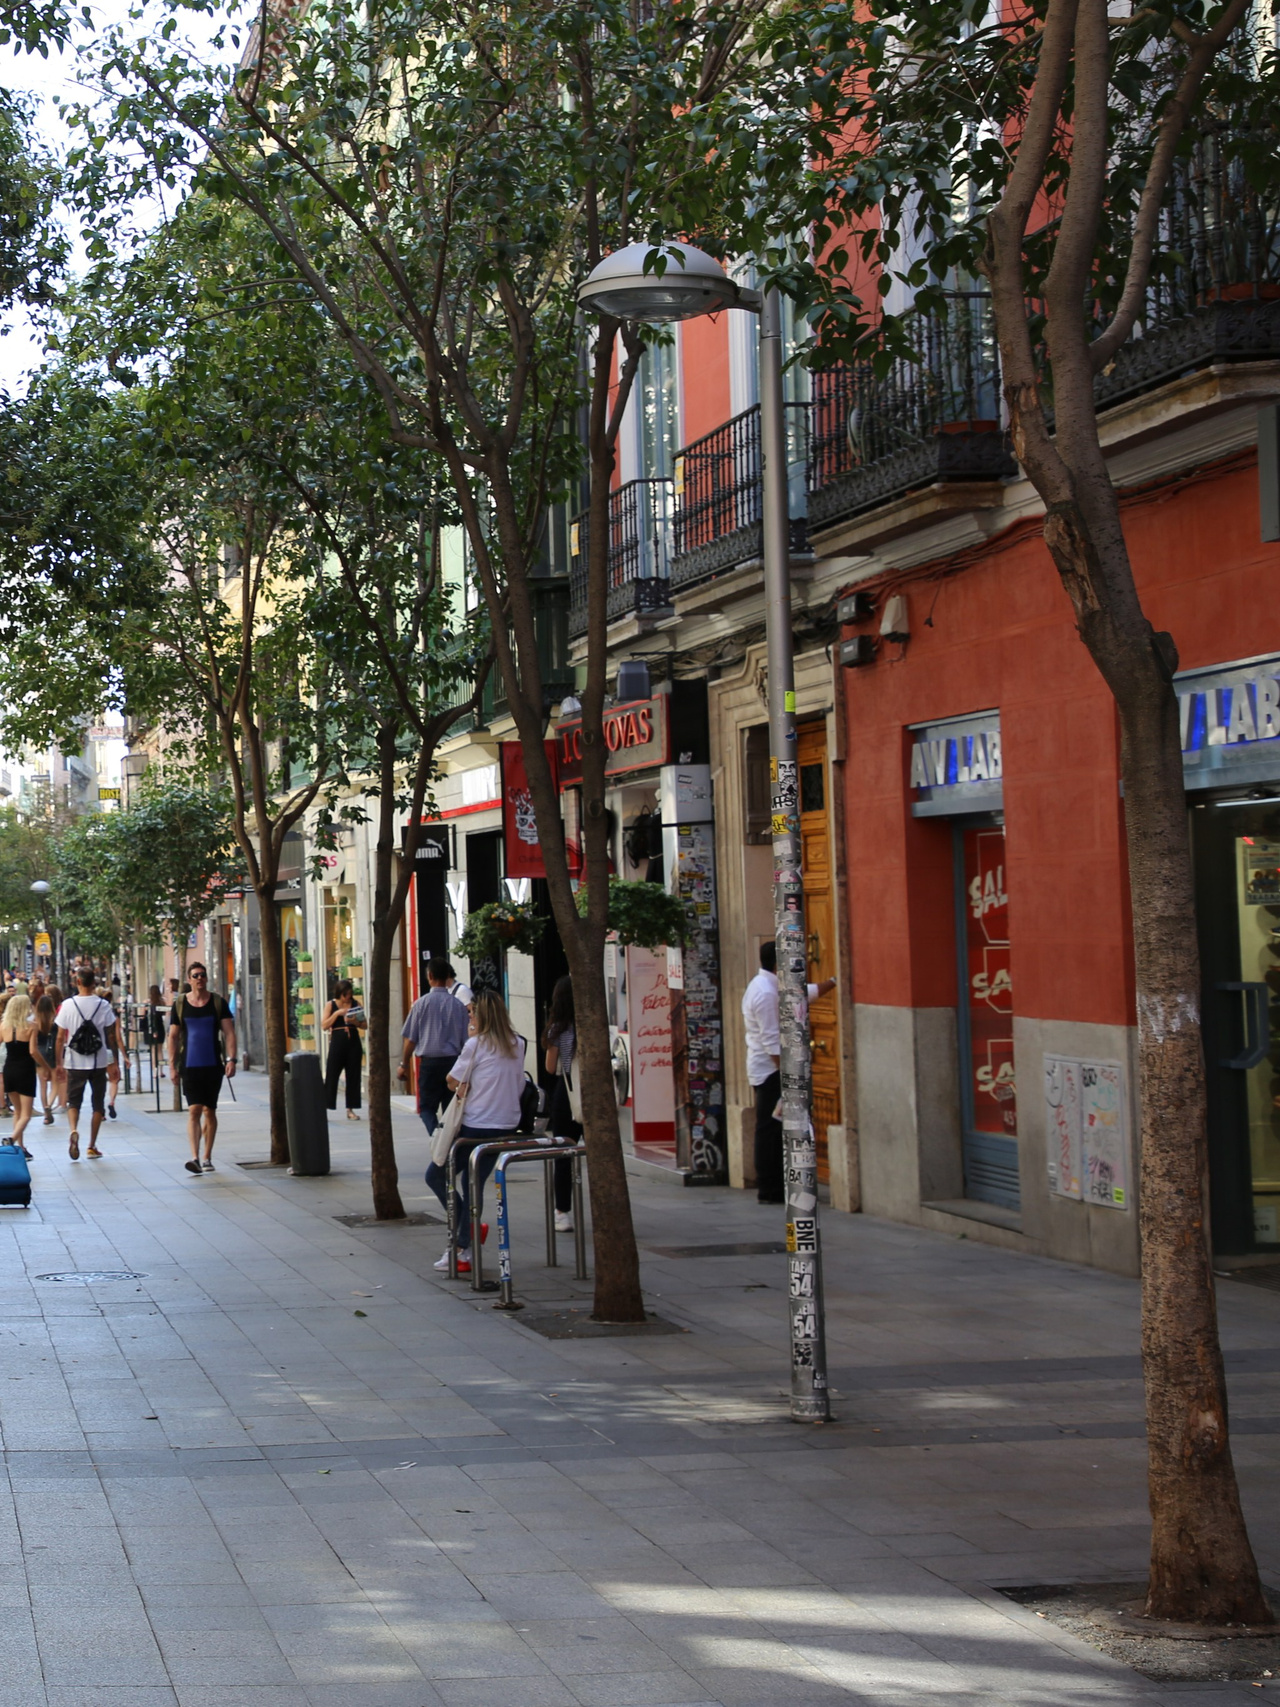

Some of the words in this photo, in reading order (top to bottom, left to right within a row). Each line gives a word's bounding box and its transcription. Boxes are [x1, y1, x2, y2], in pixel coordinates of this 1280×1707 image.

[1206, 679, 1280, 746] LAB
[910, 739, 947, 789] AW
[956, 731, 1003, 785] LAB
[796, 1220, 815, 1251] BNE
[790, 1272, 813, 1297] 54
[793, 1314, 816, 1339] 54
